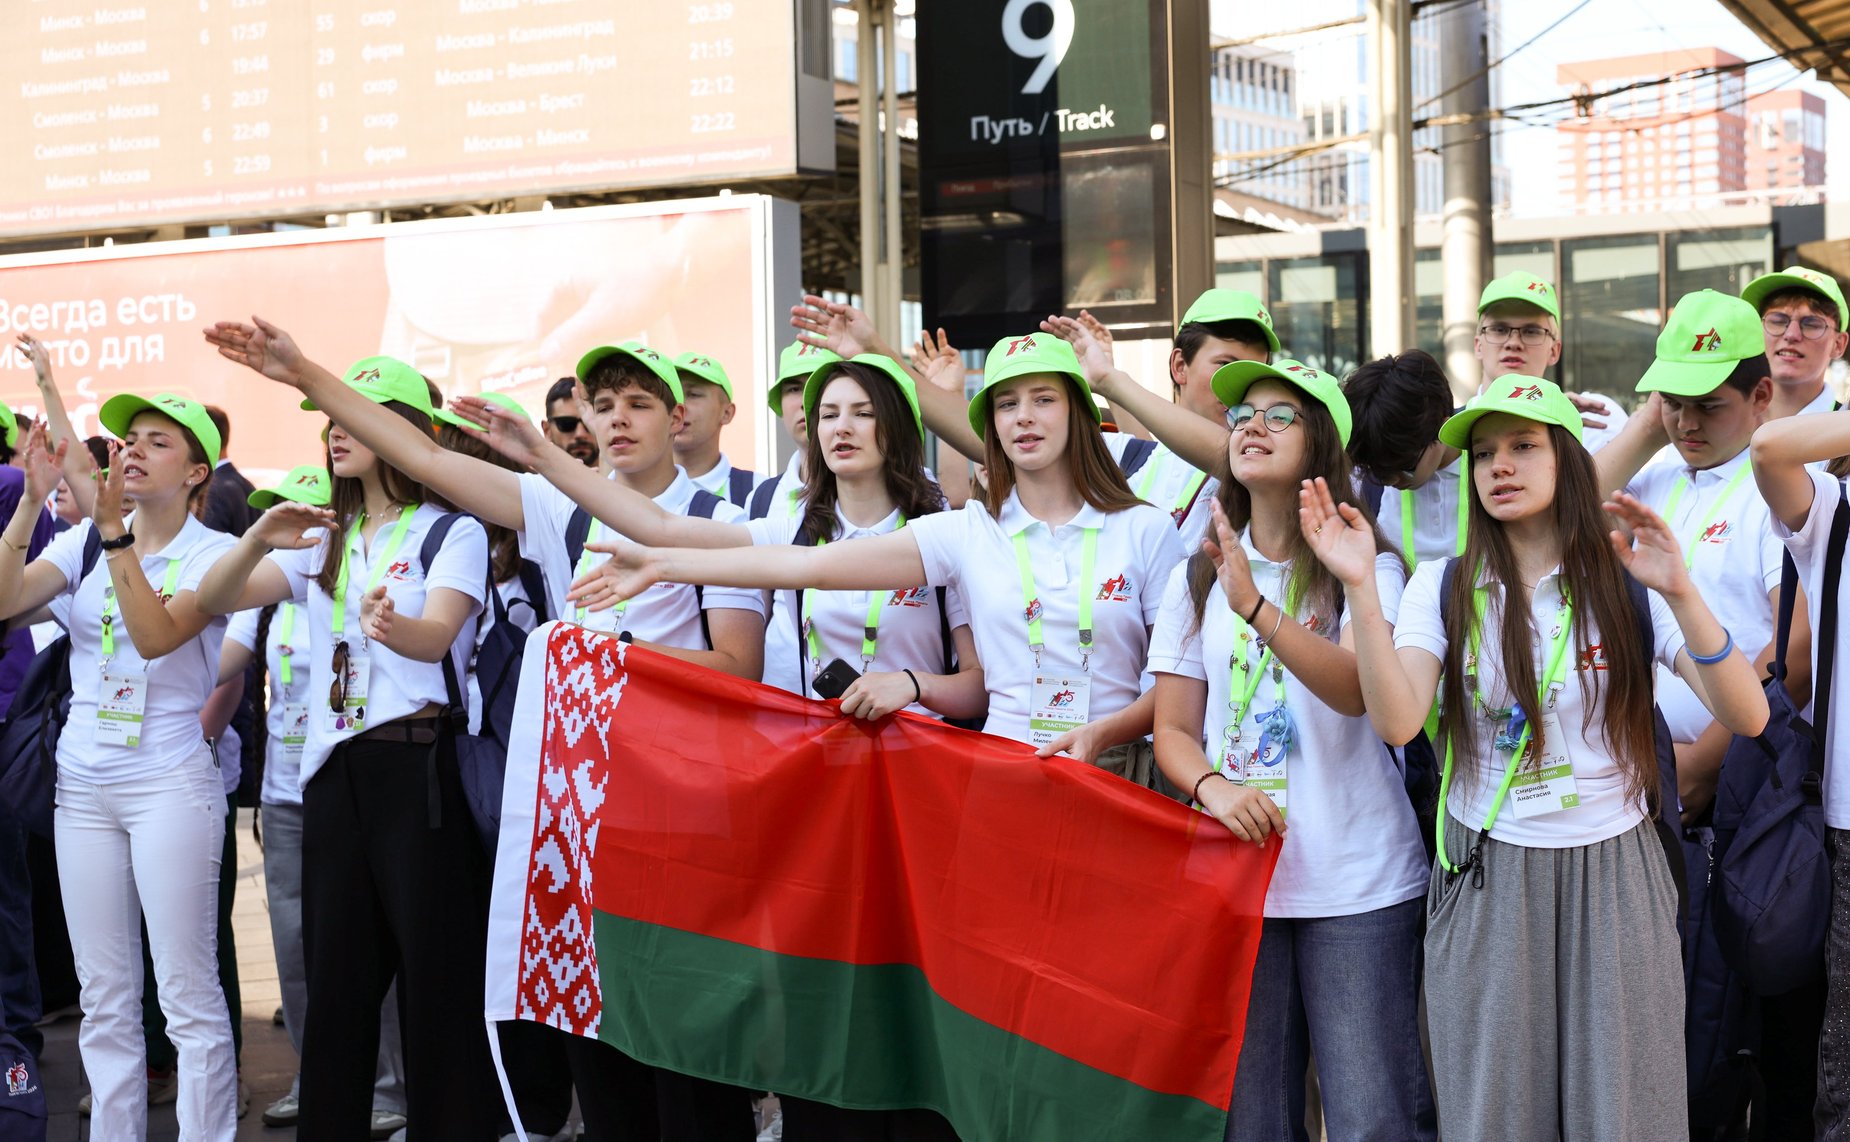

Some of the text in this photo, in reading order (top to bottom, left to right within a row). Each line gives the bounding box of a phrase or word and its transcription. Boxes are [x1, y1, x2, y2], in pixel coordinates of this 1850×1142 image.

[40, 16, 83, 32] Минск
[95, 8, 146, 24] Москва
[316, 10, 396, 32] 55 скор
[688, 2, 734, 24] 20:39
[231, 22, 267, 41] 17:57
[436, 33, 496, 51] Москва
[508, 20, 614, 43] Калининград
[41, 48, 84, 64] Минск
[96, 40, 147, 56] Москва
[318, 43, 404, 65] 29 фирм
[689, 38, 734, 60] 21:15
[1001, 0, 1076, 94] 9
[233, 55, 269, 73] 19:44
[435, 68, 493, 86] Москва
[507, 59, 574, 80] Великие
[576, 54, 617, 75] Луки
[21, 76, 107, 97] Калининград
[117, 70, 170, 86] Москва
[317, 79, 398, 98] 61 скор
[690, 75, 734, 96] 22:12
[232, 88, 269, 108] 20:37
[467, 100, 526, 117] Москва
[540, 94, 584, 113] Брест
[33, 111, 96, 128] Смоленск
[107, 104, 159, 120] Москва
[320, 113, 399, 133] 3 скор
[690, 112, 735, 133] 22:22
[970, 104, 1115, 145] Путь / Track
[233, 122, 270, 141] 22:49
[464, 136, 523, 152] Москва
[536, 129, 589, 145] Минск
[34, 143, 97, 160] Смоленск
[107, 137, 160, 152] Москва
[364, 147, 407, 165] фирм
[233, 155, 271, 175] 22:59
[45, 175, 88, 190] Минск
[100, 169, 150, 184] Москва
[116, 293, 197, 326] есть
[98, 333, 165, 371] для
[1520, 769, 1559, 782] УЧАСТНИК
[1515, 784, 1549, 795] Смирнова
[1517, 790, 1552, 802] Анастасия
